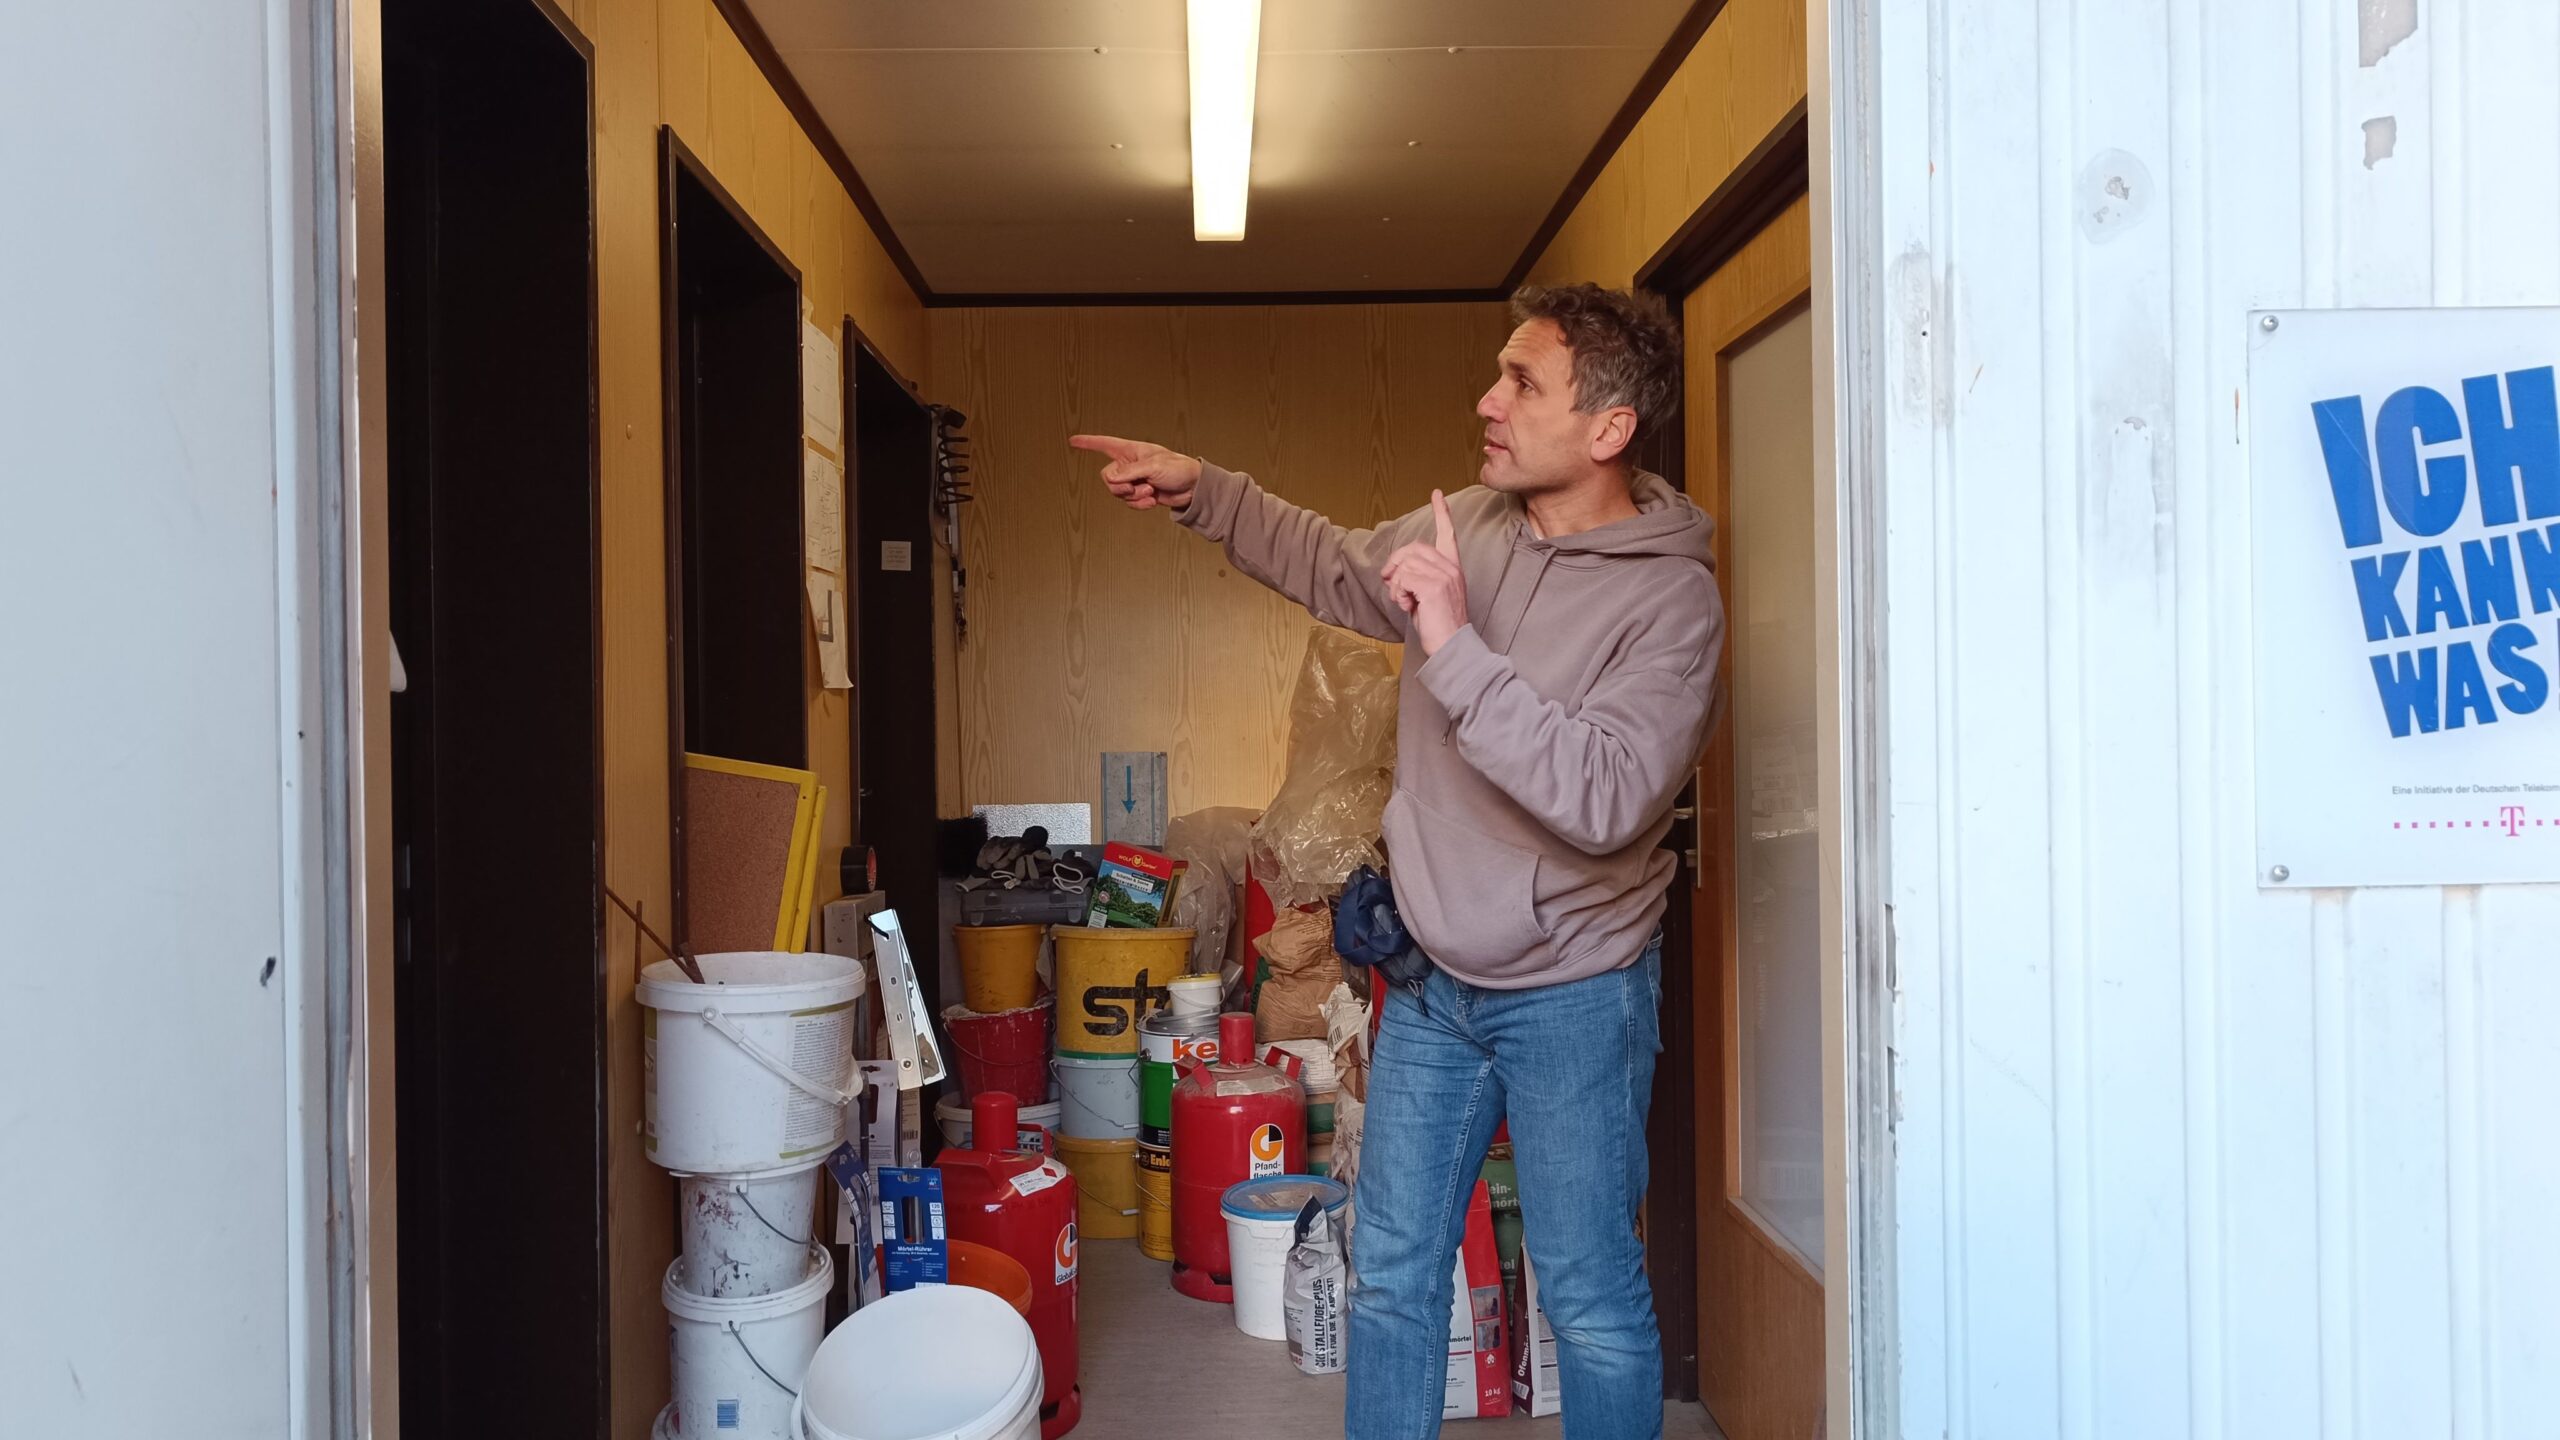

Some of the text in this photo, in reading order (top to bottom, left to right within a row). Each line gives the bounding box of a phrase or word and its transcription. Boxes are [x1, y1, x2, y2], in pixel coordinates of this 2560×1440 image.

[2311, 366, 2560, 548] ICH
[2351, 522, 2560, 642] KANN
[2369, 618, 2560, 738] WAS
[2392, 786, 2412, 795] Eine
[2414, 785, 2453, 794] Initiative
[2455, 785, 2470, 794] der
[2473, 784, 2520, 793] Deutschen
[1083, 968, 1170, 1036] st
[1255, 1161, 1281, 1171] Pfand-
